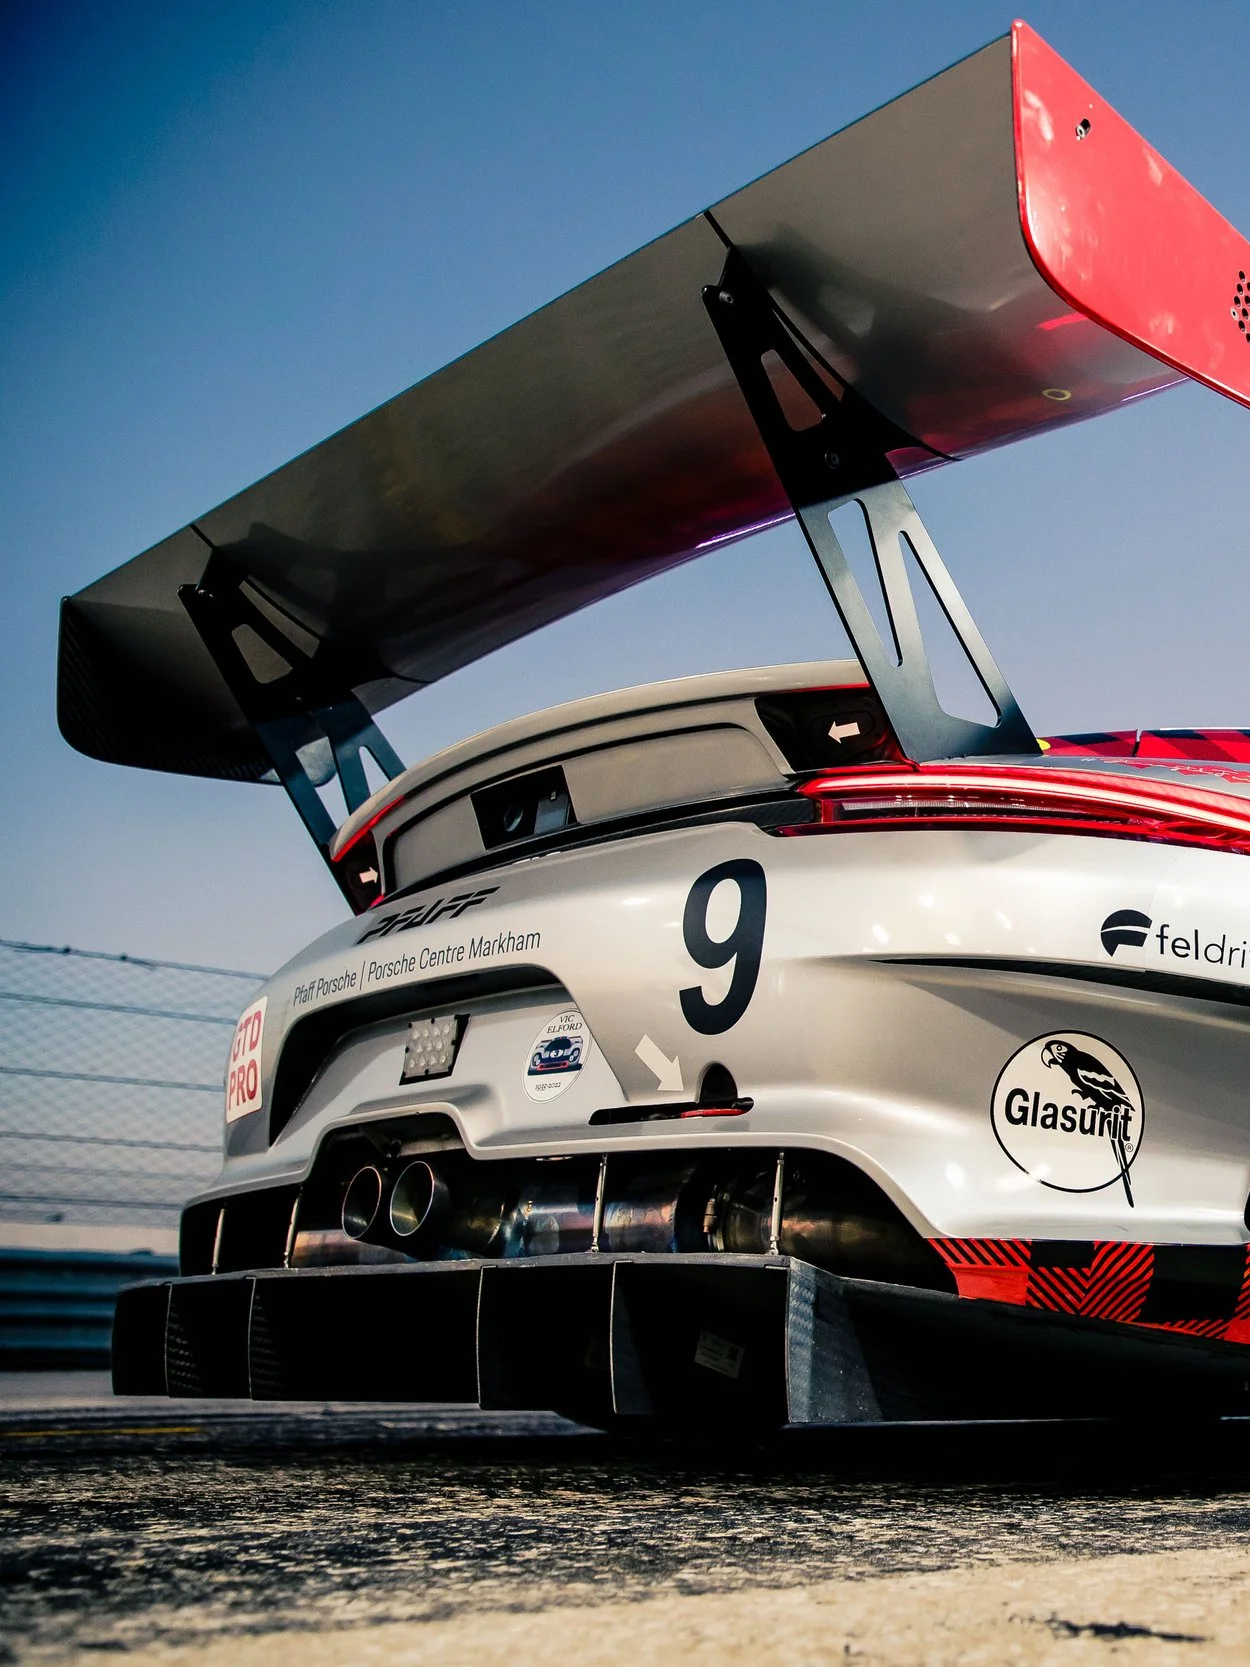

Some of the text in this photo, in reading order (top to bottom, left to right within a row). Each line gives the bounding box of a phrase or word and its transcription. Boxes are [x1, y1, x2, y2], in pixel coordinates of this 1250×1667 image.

[293, 979, 317, 1007] Pfaff
[316, 970, 357, 999] Porsche
[367, 953, 416, 983] Porsche
[419, 945, 465, 970] Centre
[468, 931, 541, 960] Markham
[678, 858, 768, 1036] 9
[232, 1010, 262, 1062] GTD
[546, 1022, 583, 1034] ELFORD
[560, 1014, 576, 1024] VIC
[228, 1058, 258, 1111] PRO
[1004, 1087, 1134, 1142] Glasurit
